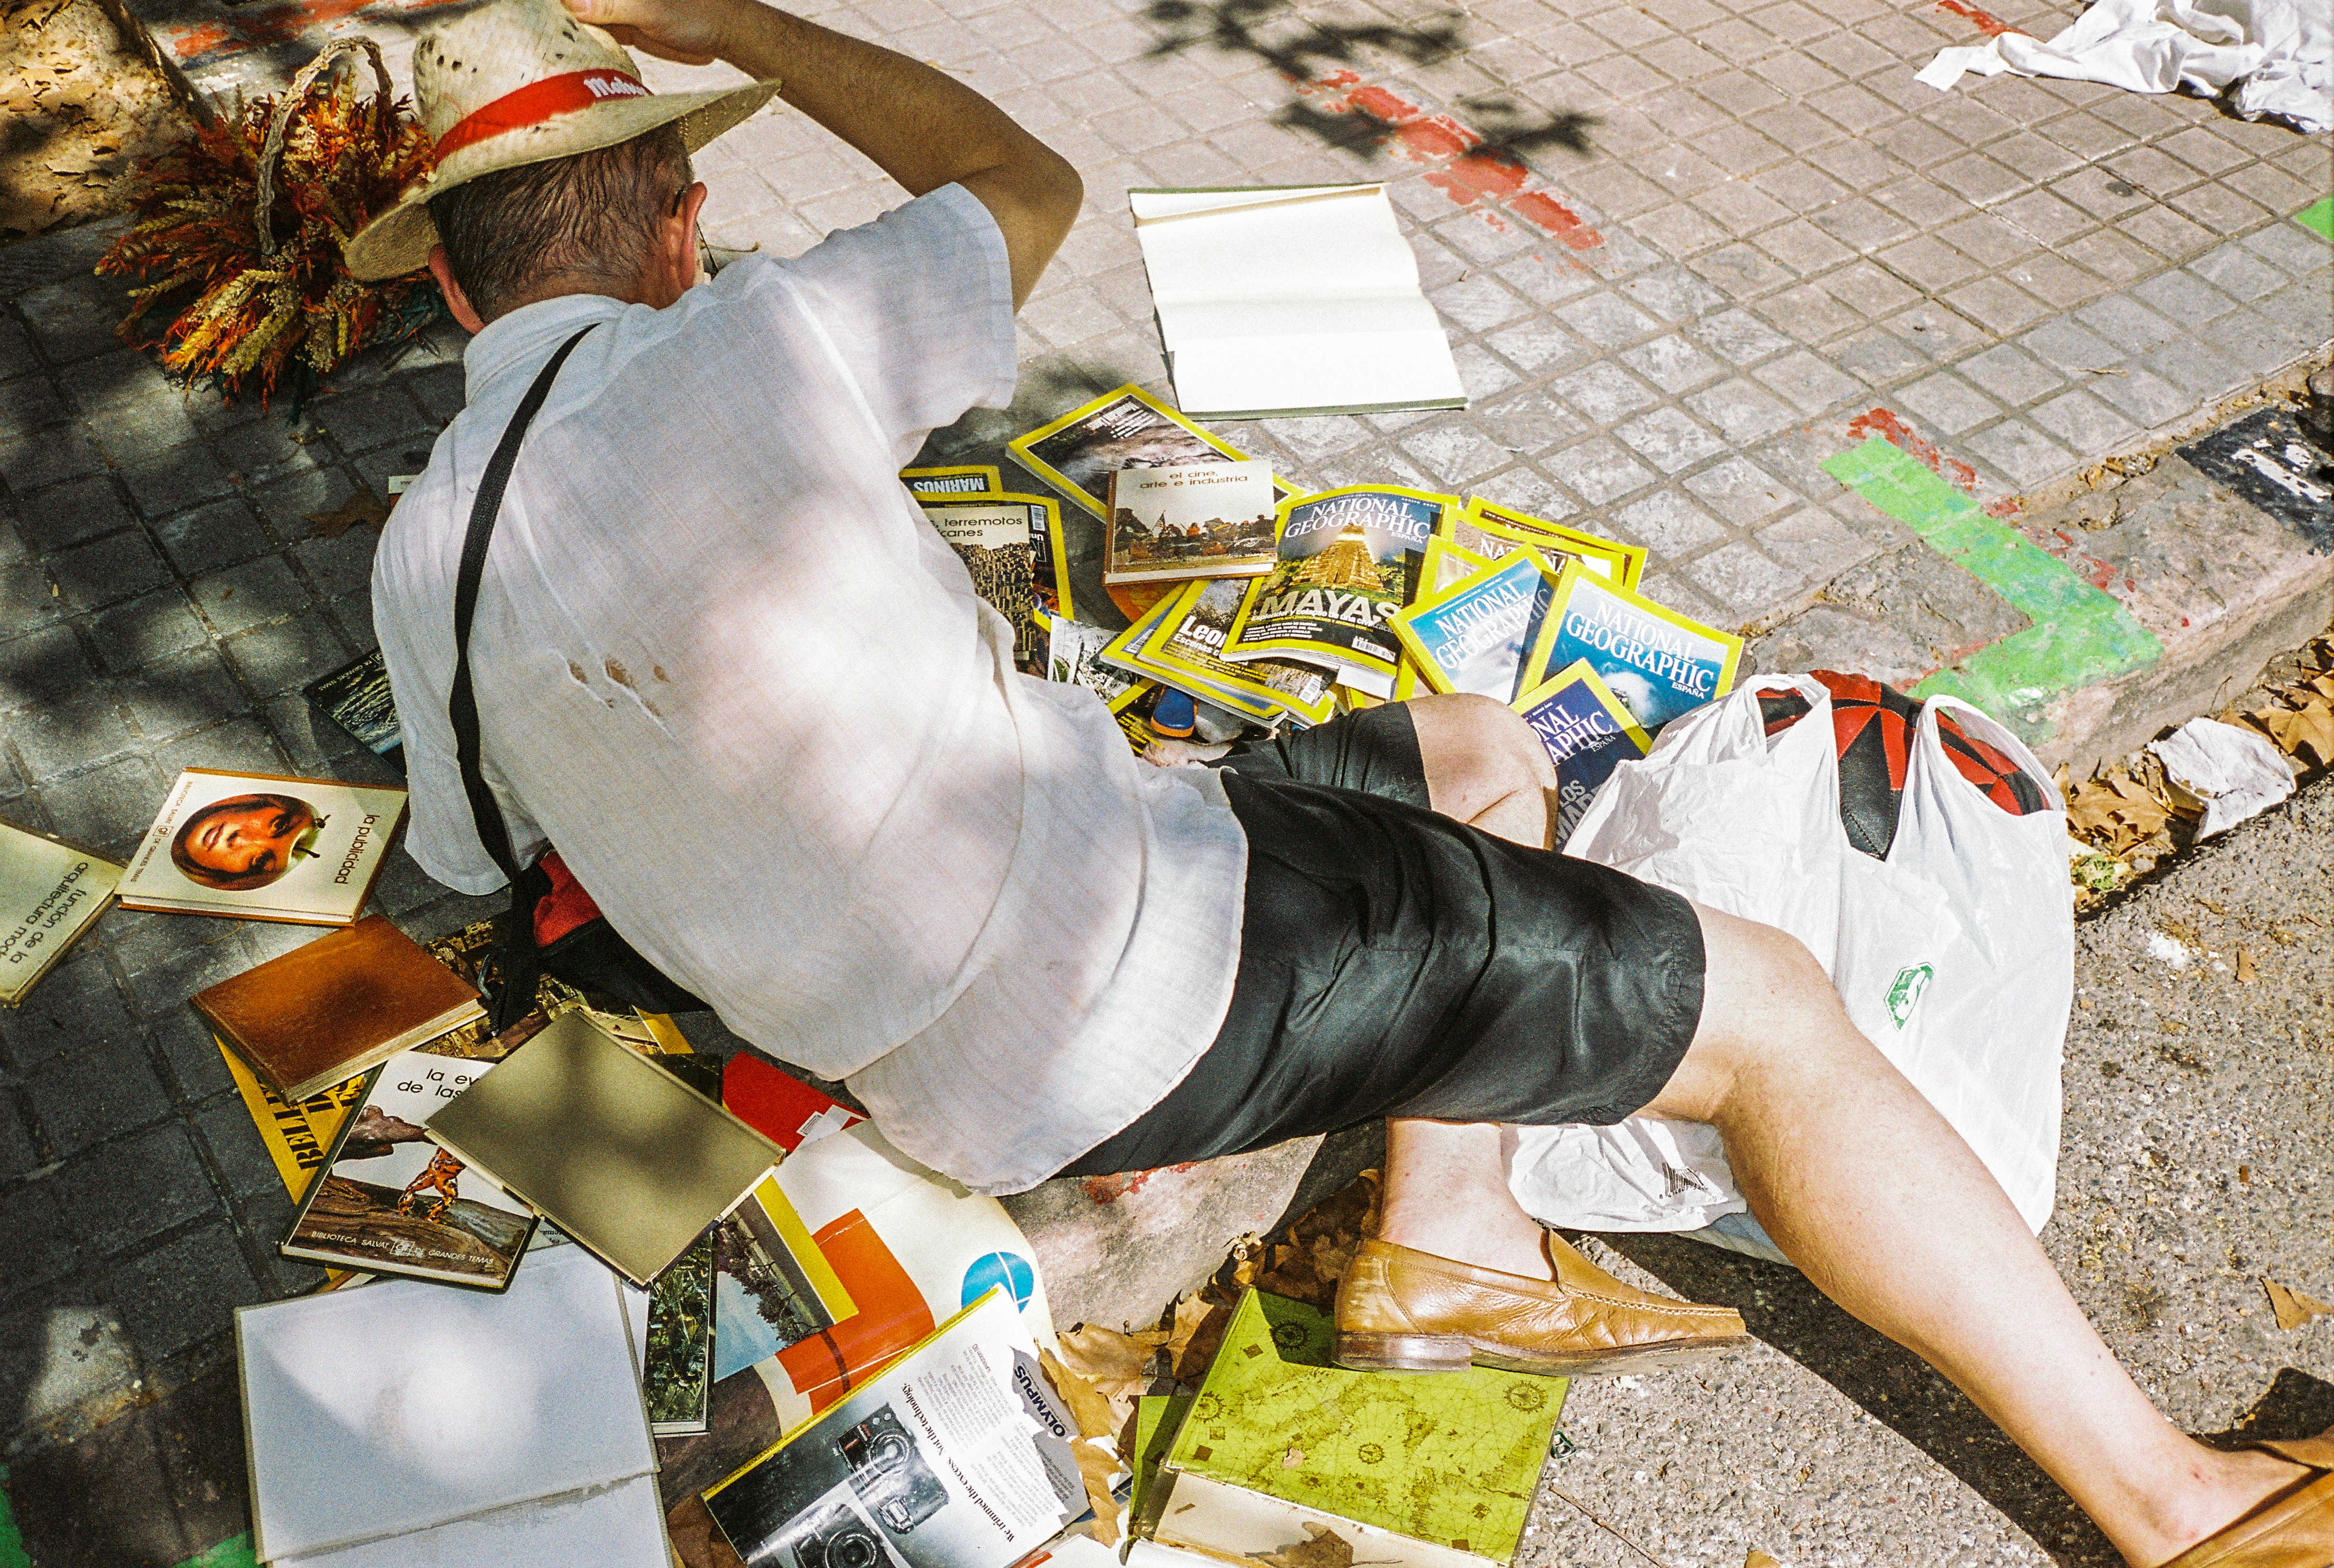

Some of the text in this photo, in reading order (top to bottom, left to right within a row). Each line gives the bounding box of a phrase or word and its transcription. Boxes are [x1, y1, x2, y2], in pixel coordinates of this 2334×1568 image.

[914, 477, 985, 493] MARINUS
[1189, 476, 1248, 486] industria
[945, 517, 1023, 527] terremotos
[1311, 498, 1413, 519] NATIONAL
[1285, 512, 1430, 539] GEOGRAPHIC
[1391, 532, 1423, 544] ESPAÑA
[1260, 589, 1402, 623] MAYAS
[1296, 609, 1328, 619] colapso
[1340, 613, 1356, 623] una
[1435, 581, 1527, 640] NATIONAL
[1436, 588, 1550, 669] GEOGRAPHIC
[1594, 601, 1695, 663] NATIONAL
[1173, 632, 1212, 653] Escenas
[1566, 612, 1714, 692] GEOGRAPHIC
[1672, 682, 1704, 699] ESPAÑA
[1530, 704, 1580, 742] NAL
[1591, 734, 1616, 753] ESPAÑA
[1560, 780, 1586, 807] LOS
[334, 814, 380, 884] la publicidad
[26, 862, 89, 925] arquitectura
[9, 889, 87, 964] función de la
[398, 1081, 423, 1093] de
[426, 1069, 445, 1081] la
[311, 1231, 357, 1244] BIBLIOTECA
[362, 1239, 390, 1249] SALVAT
[428, 1249, 466, 1261] GRANDES
[468, 1255, 494, 1265] TEMAS
[901, 1383, 928, 1427] technology.
[1015, 1365, 1065, 1437] OLYMPUS
[925, 1426, 937, 1441] the
[948, 1457, 968, 1486] excess.
[965, 1485, 978, 1500] the
[974, 1497, 1008, 1530] trimmed
[1004, 1529, 1015, 1542] We
